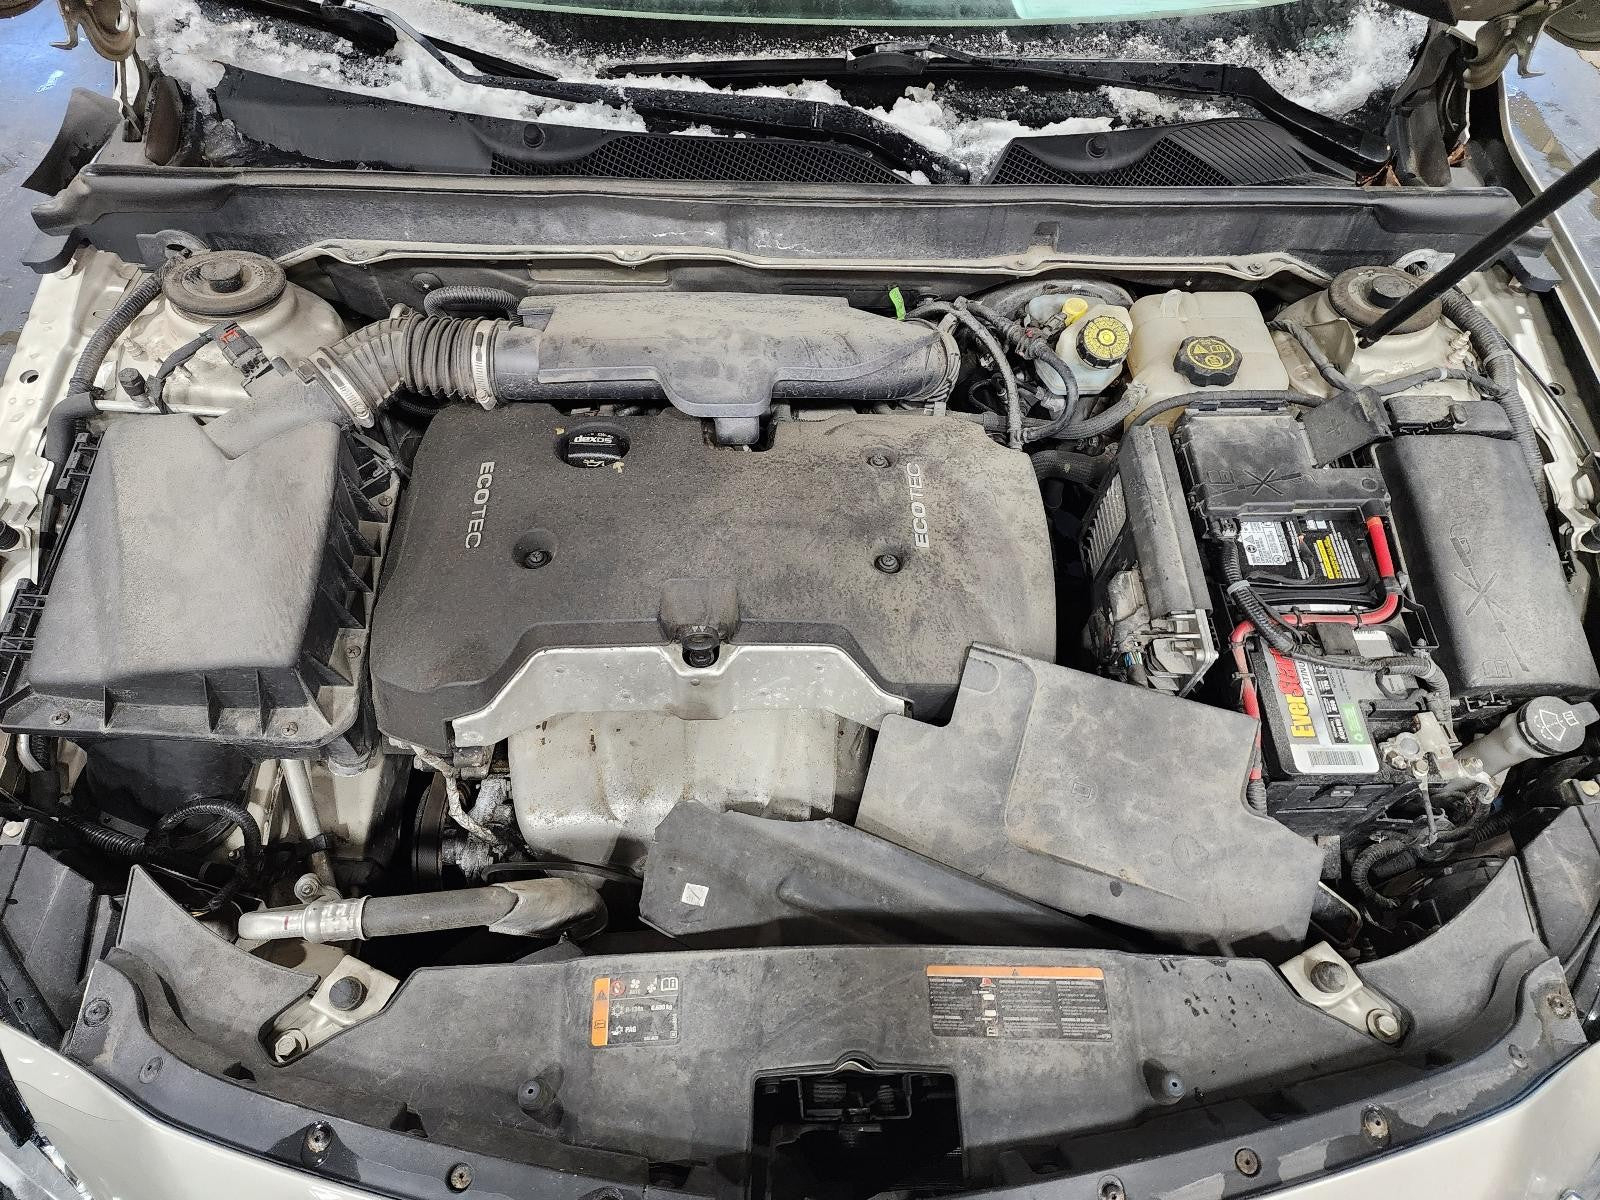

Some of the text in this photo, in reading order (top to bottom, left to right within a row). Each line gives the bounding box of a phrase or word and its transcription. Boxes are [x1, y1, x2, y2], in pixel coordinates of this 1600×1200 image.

[574, 434, 613, 444] dexos
[465, 461, 495, 549] ECOTEC
[907, 462, 930, 548] ECOTEC
[1298, 661, 1313, 696] PLATINU
